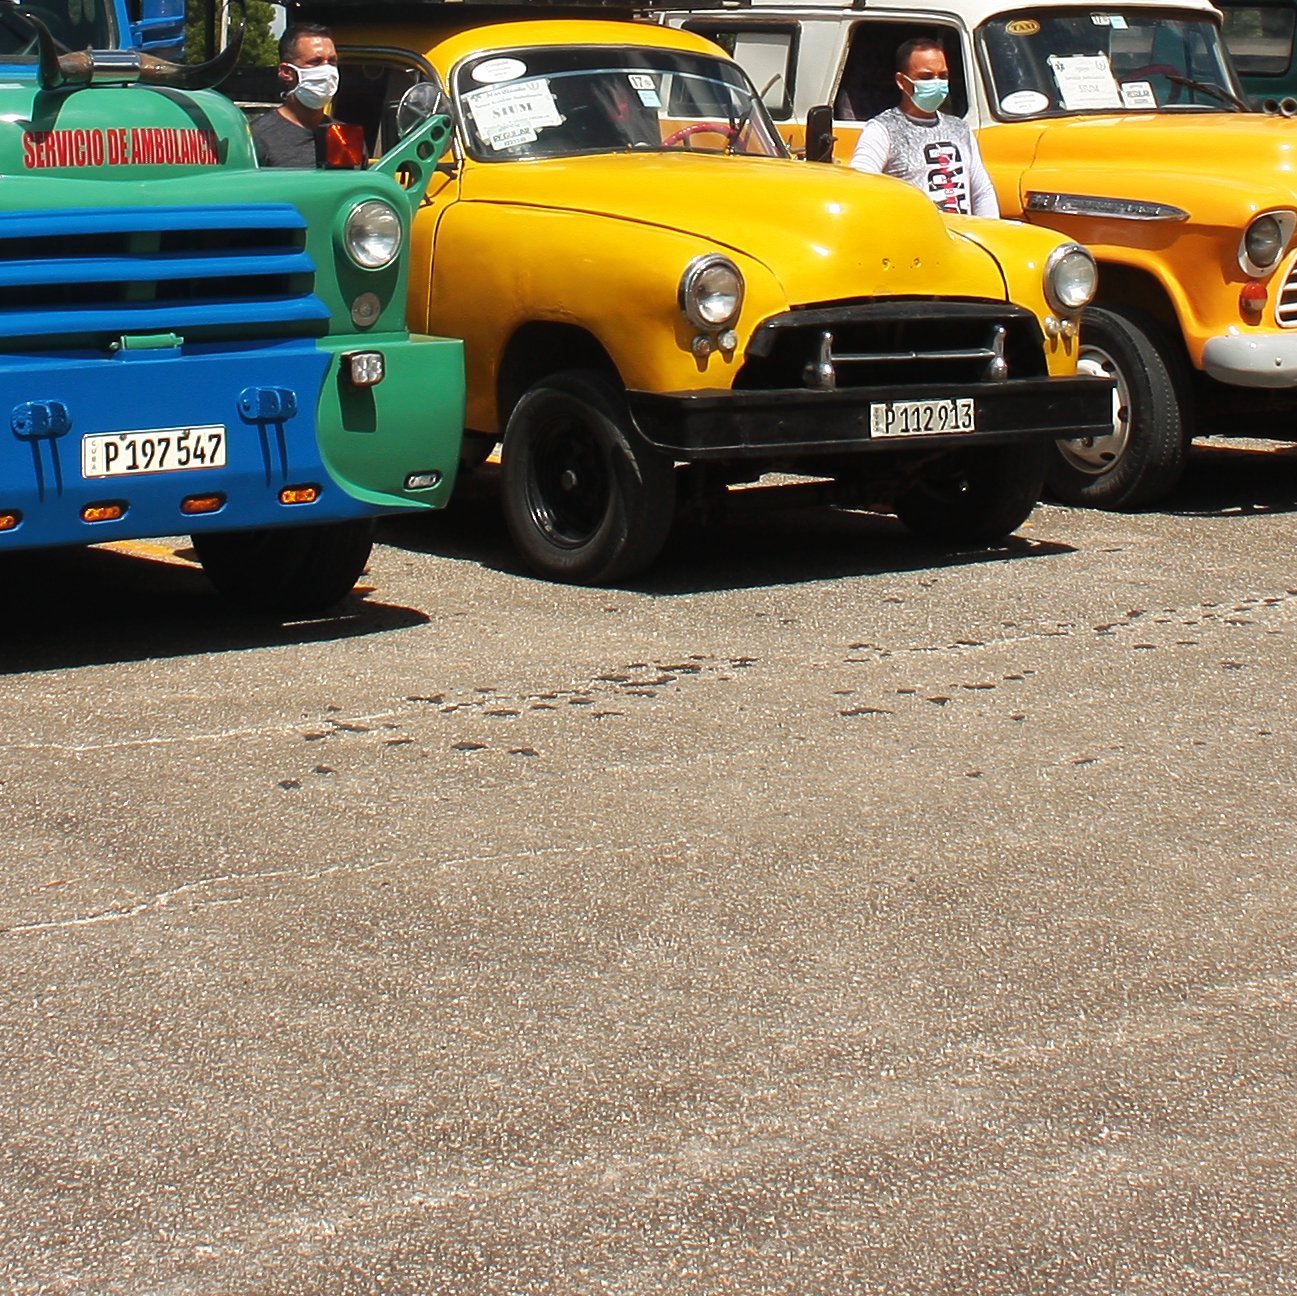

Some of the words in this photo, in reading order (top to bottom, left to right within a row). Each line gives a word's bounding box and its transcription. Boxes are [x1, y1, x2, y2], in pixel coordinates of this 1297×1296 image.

[22, 129, 104, 170] SERVICIO
[107, 128, 129, 166] DE
[131, 127, 221, 166] AMBULANCIA
